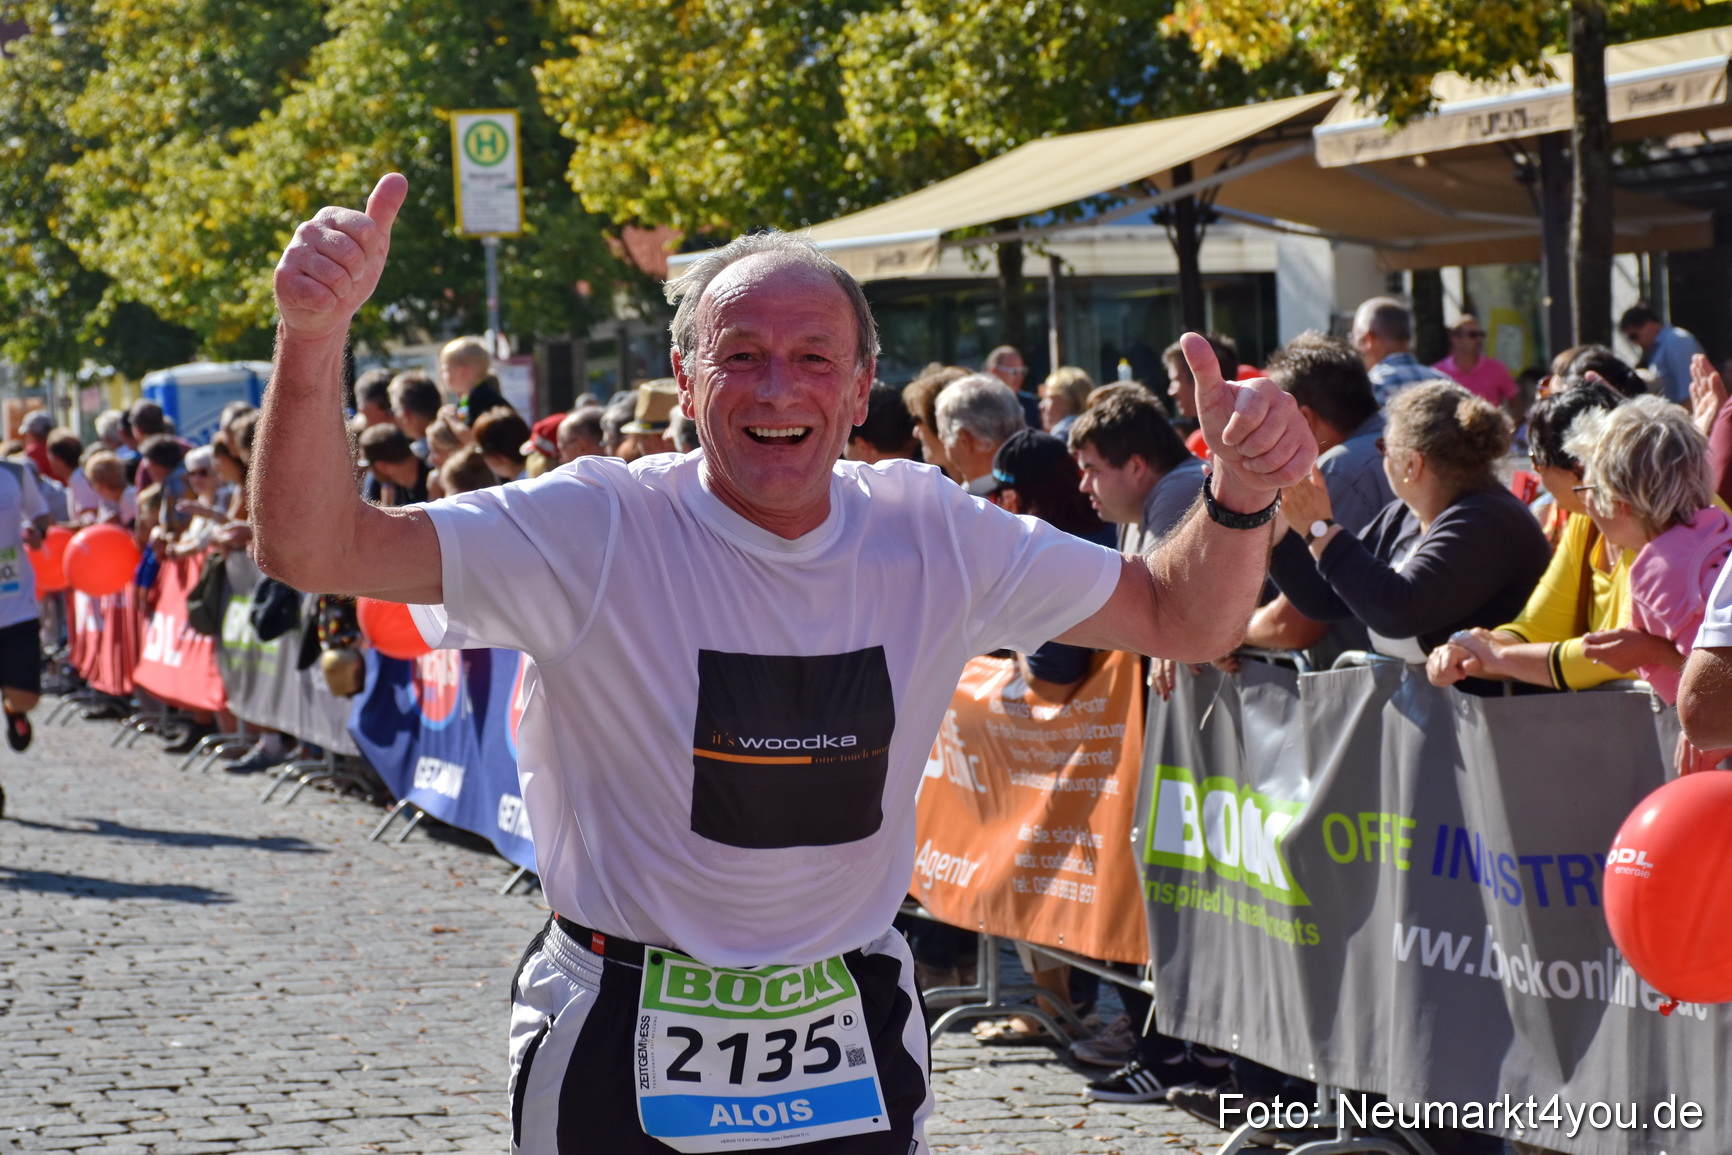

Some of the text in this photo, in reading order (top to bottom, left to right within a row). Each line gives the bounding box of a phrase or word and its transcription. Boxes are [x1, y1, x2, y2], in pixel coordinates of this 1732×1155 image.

[738, 734, 857, 750] woodka
[815, 756, 836, 764] one
[840, 748, 869, 763] touch
[914, 838, 979, 890] Agentur
[1614, 865, 1651, 880] energie
[1141, 871, 1221, 914] inspired
[663, 960, 839, 1009] BOCK
[666, 1014, 853, 1086] 2135 D
[709, 1099, 814, 1128] ALOIS
